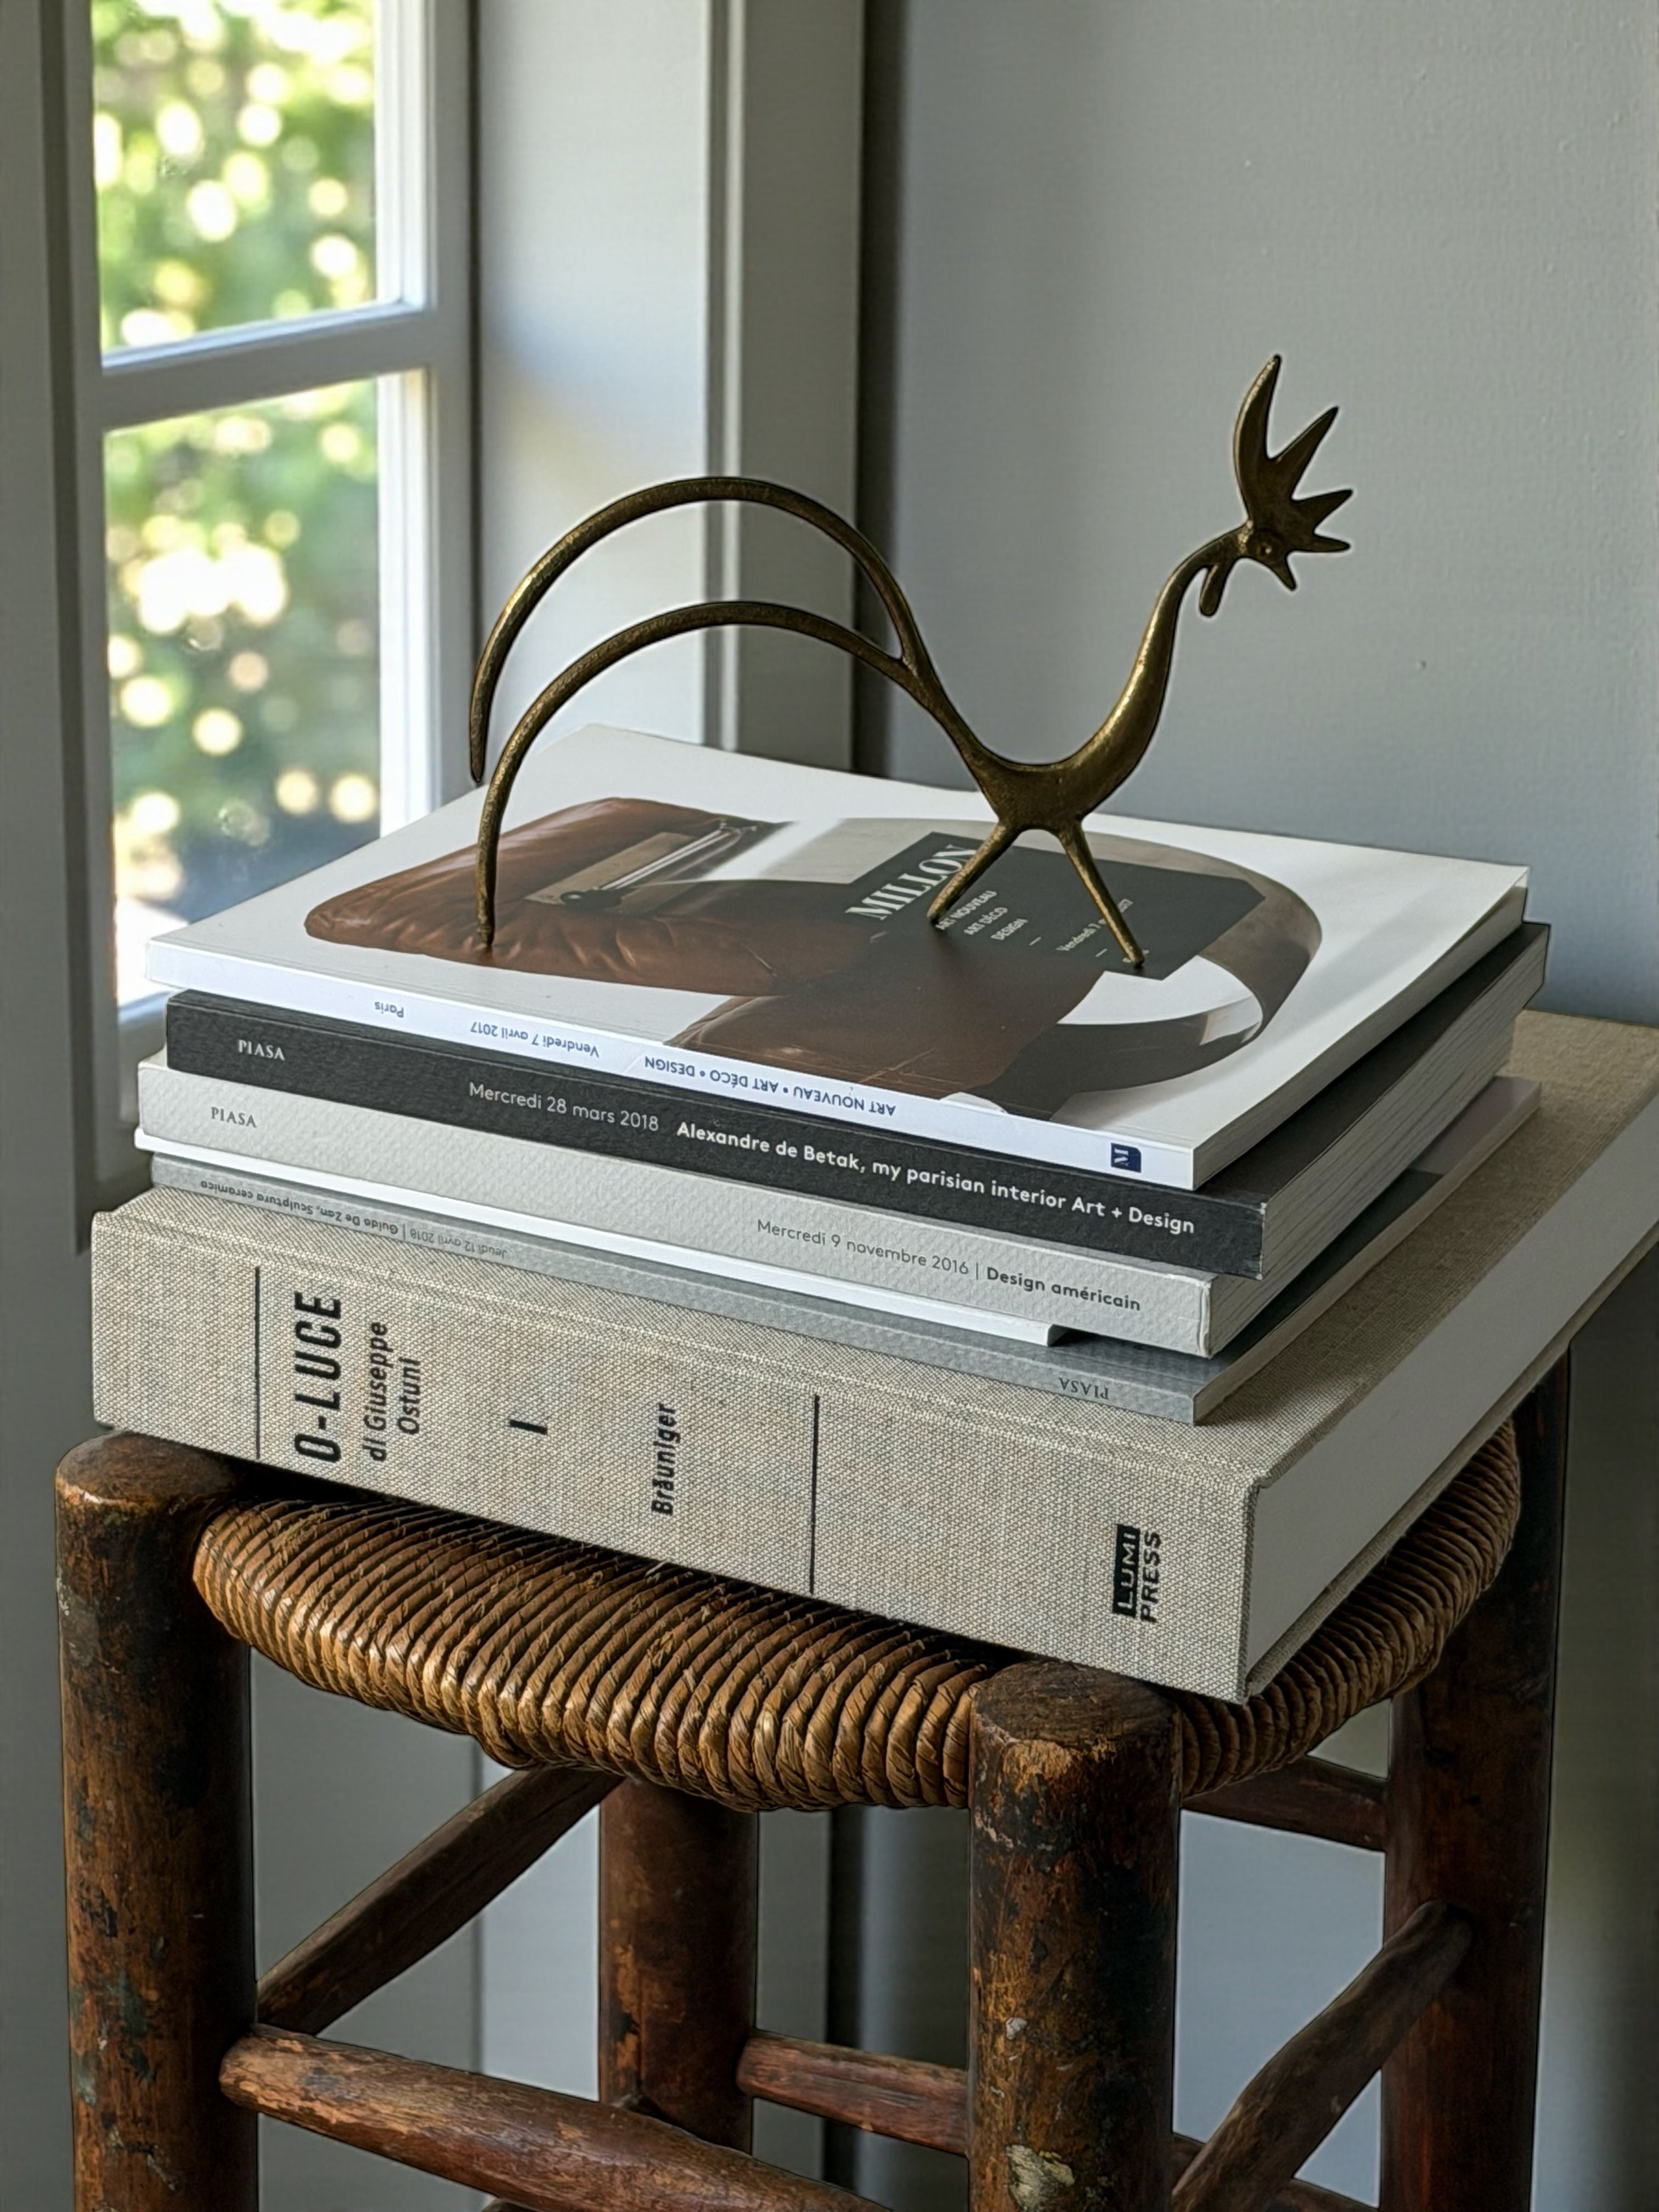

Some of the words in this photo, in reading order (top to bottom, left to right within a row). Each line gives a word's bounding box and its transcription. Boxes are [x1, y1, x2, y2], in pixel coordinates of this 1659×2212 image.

[845, 844, 977, 921] MILLON
[935, 917, 956, 930] ART
[950, 890, 997, 918] NOUVEAU
[964, 922, 985, 935] ART
[979, 907, 1008, 924] DÉCO
[991, 918, 1028, 940] DESIGN
[374, 1000, 404, 1018] Paris
[470, 1022, 498, 1037] 2017
[501, 1026, 528, 1041] avril
[532, 1034, 539, 1046] 7
[237, 1039, 285, 1061] PIASA
[543, 1035, 599, 1058] Vendredi
[645, 1056, 695, 1077] DESIGN
[709, 1069, 748, 1088] DÉCO
[752, 1077, 778, 1093] ART
[469, 1082, 541, 1109] Mercredi
[547, 1096, 567, 1114] 28
[573, 1104, 614, 1124] mars
[620, 1111, 658, 1131] 2018
[793, 1086, 864, 1110] NOUVEAU
[870, 1102, 896, 1116] ART
[211, 1106, 257, 1128] PIASA
[676, 1121, 770, 1152] Alexandre
[776, 1141, 798, 1158] de
[804, 1146, 865, 1173] Betak,
[872, 1161, 901, 1181] my
[907, 1168, 985, 1194] parisian
[991, 1180, 1066, 1208] interior
[1071, 1197, 1105, 1216] Art
[1111, 1207, 1122, 1218] +
[1128, 1207, 1194, 1234] Design
[201, 1181, 253, 1199] ceramica
[346, 1214, 361, 1227] De
[364, 1218, 399, 1235] Guido
[410, 1228, 435, 1242] 2018
[438, 1234, 461, 1247] avril
[465, 1240, 475, 1252] 12
[478, 1244, 508, 1259] Jeudi
[758, 1219, 826, 1246] Mercredi
[831, 1234, 841, 1249] 9
[847, 1239, 927, 1267] novembre
[932, 1255, 969, 1276] 2016
[988, 1267, 1046, 1292] Design
[1051, 1282, 1141, 1312] américain
[294, 1291, 342, 1463] O-LUCE
[363, 1322, 393, 1431] Giuseppe
[397, 1356, 421, 1435] Ostuni
[1059, 1377, 1109, 1400] PIASA
[362, 1438, 387, 1462] di
[1117, 1532, 1136, 1610] LUMI
[1140, 1530, 1161, 1623] PRESS
